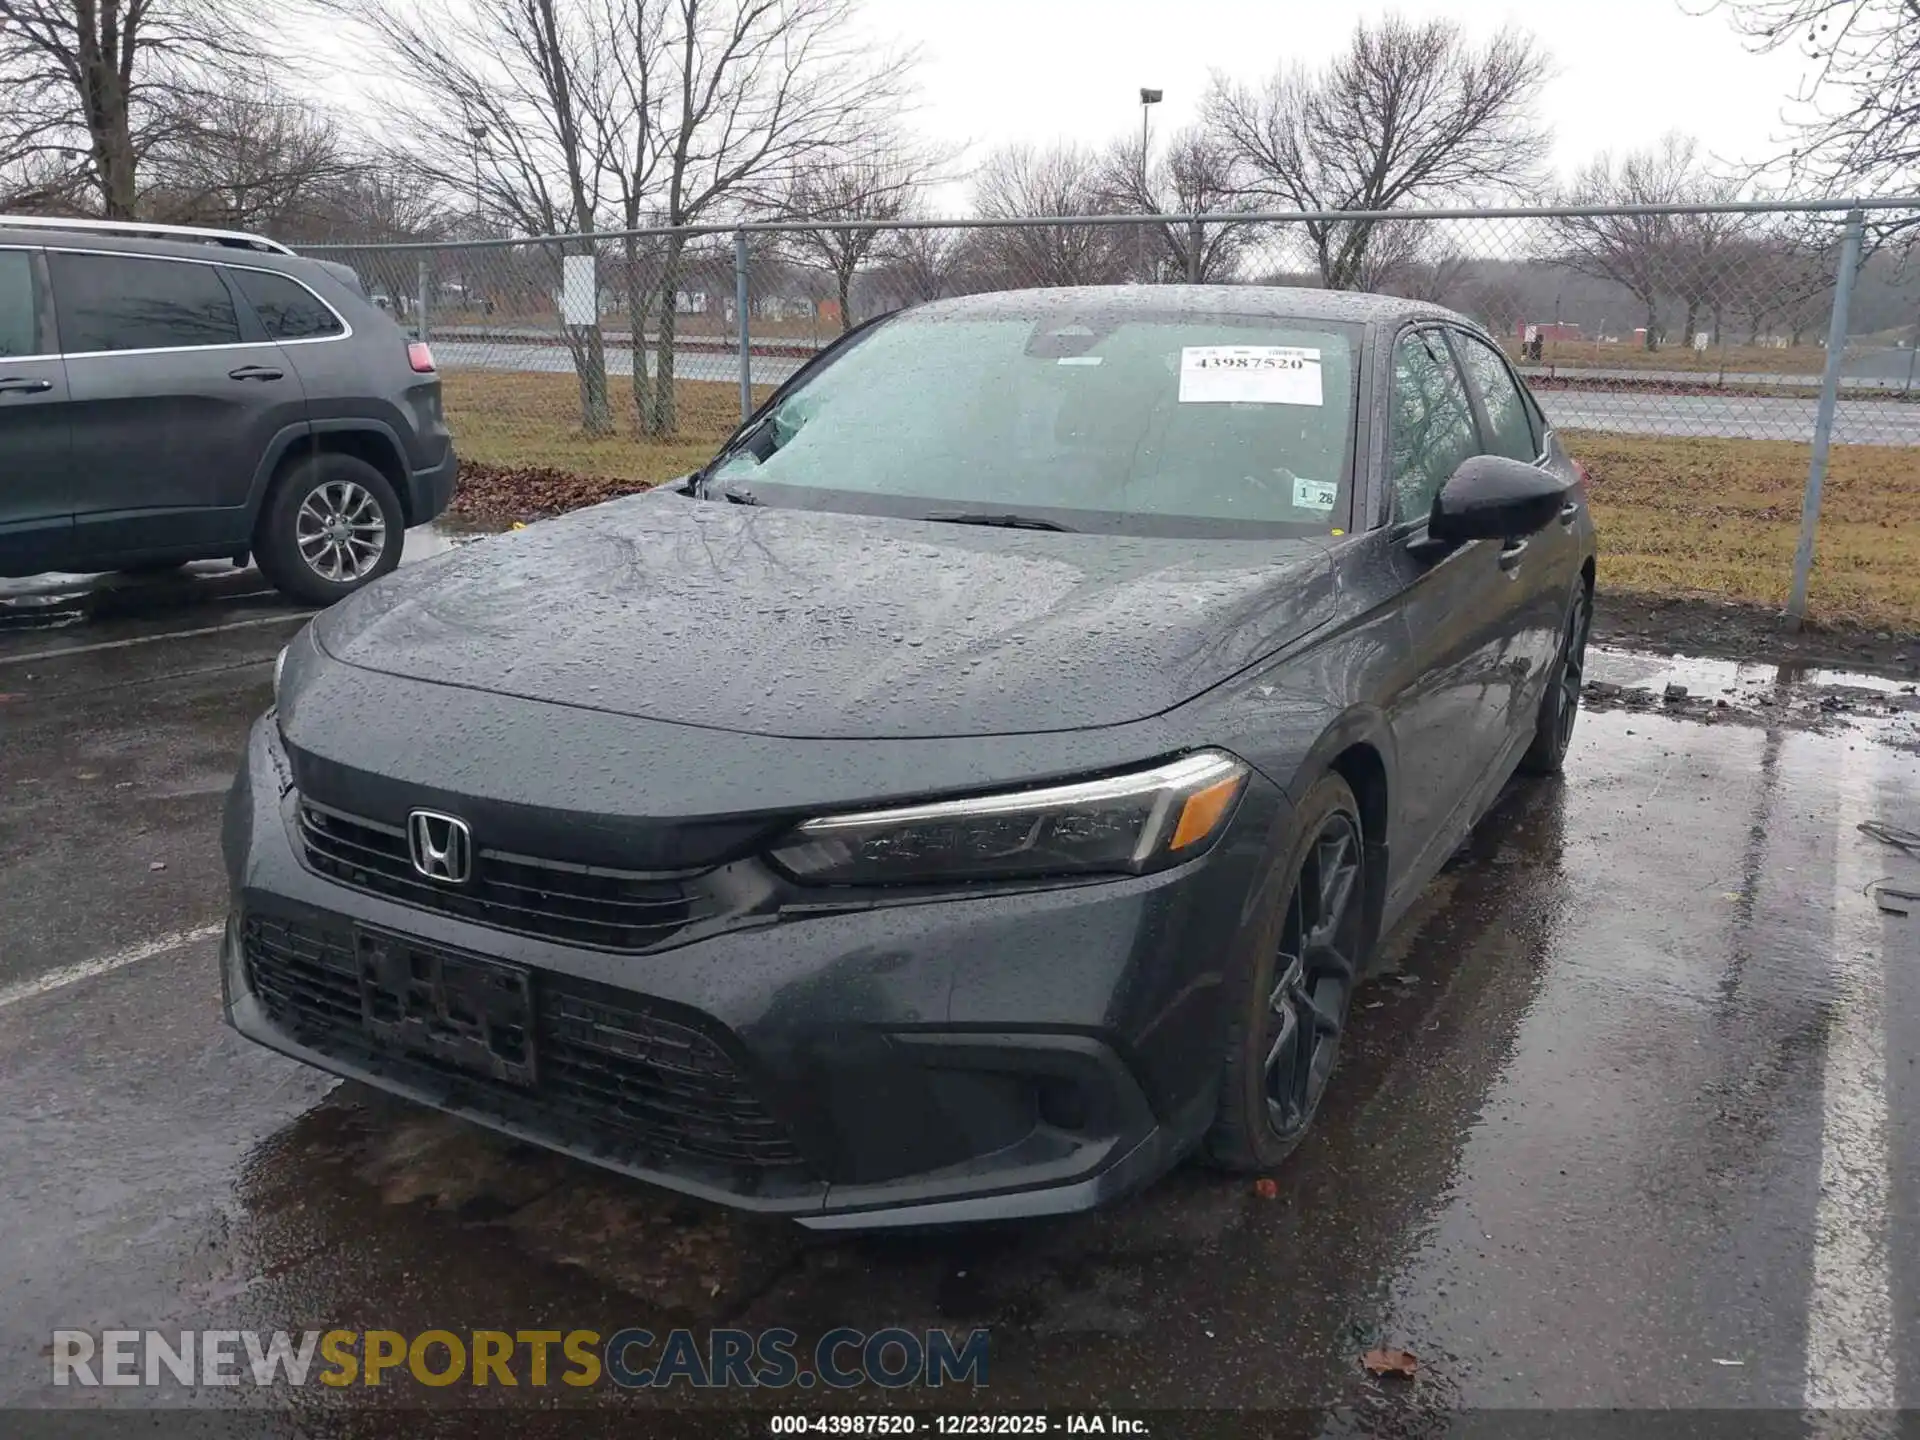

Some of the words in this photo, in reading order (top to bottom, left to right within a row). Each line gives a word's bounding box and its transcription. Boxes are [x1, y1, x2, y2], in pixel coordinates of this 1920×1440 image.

[1195, 357, 1303, 369] 43987520
[1300, 487, 1308, 498] 1
[1318, 492, 1334, 504] 28
